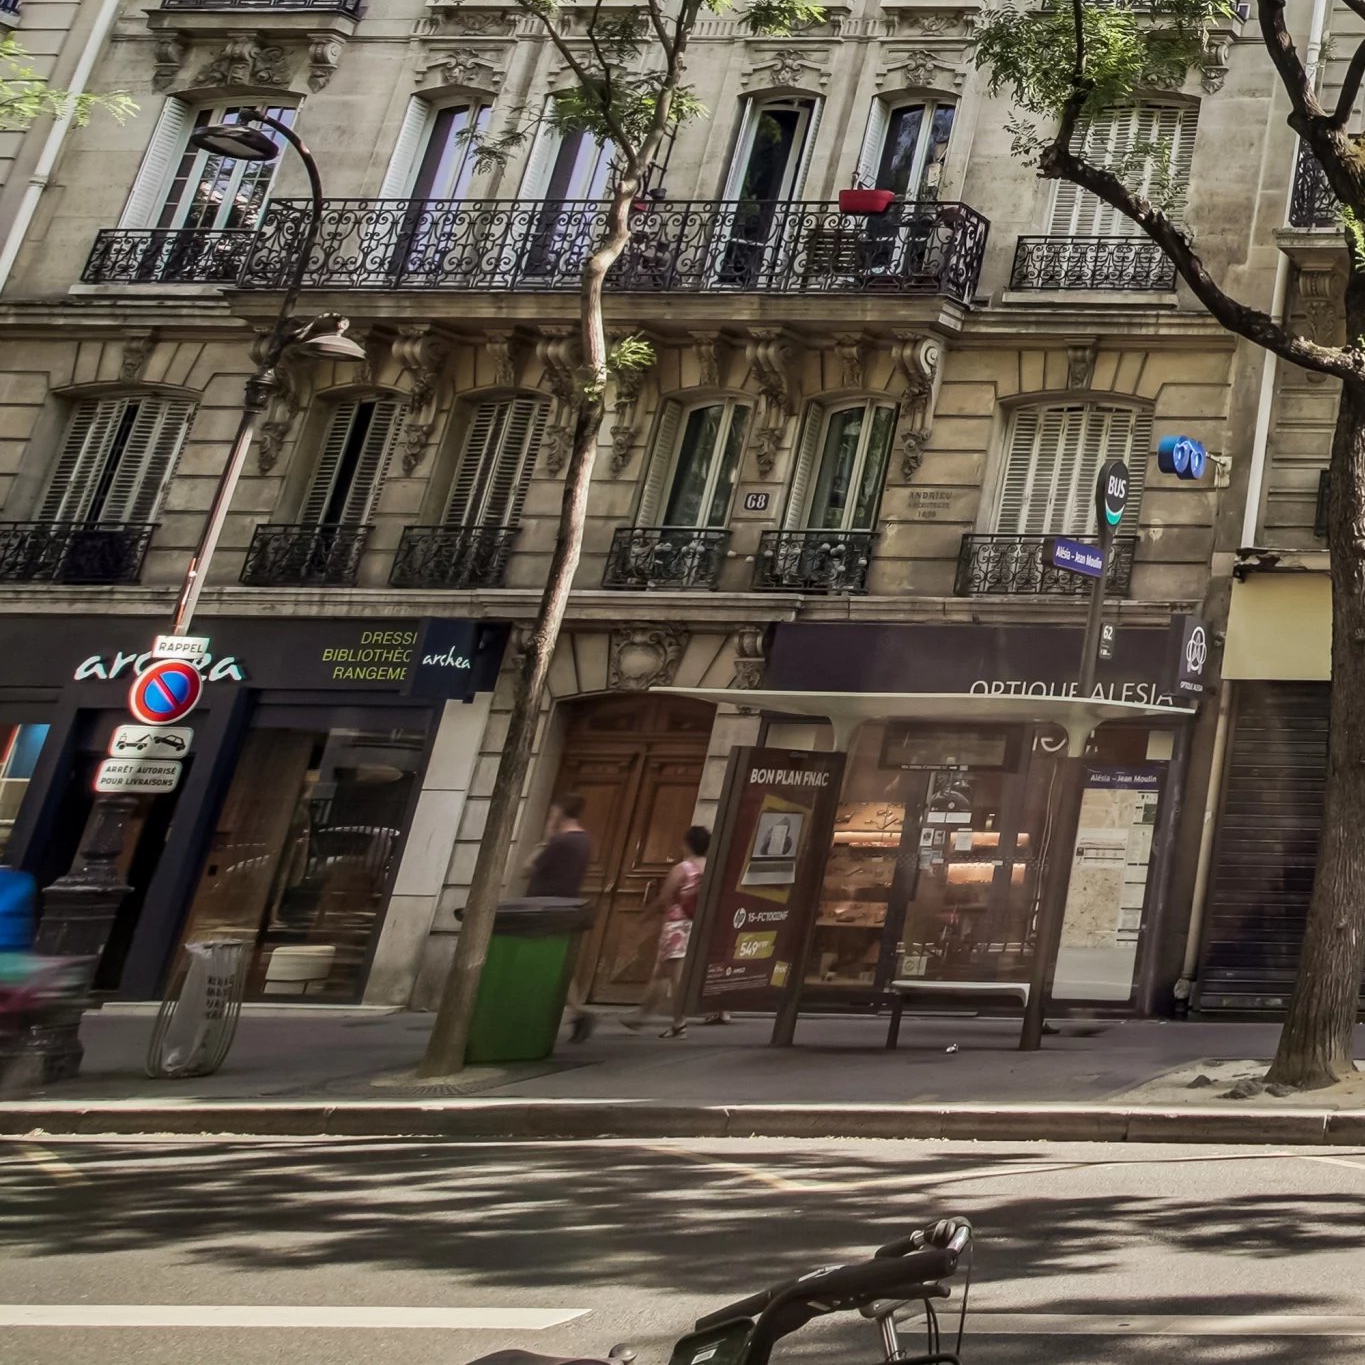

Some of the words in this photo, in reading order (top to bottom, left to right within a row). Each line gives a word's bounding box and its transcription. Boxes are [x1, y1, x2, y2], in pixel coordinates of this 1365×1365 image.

[1108, 475, 1126, 498] BUS
[747, 495, 766, 508] 68
[1056, 546, 1070, 560] Alésia
[1075, 551, 1086, 564] Jean
[361, 632, 417, 644] DRESSI
[1103, 625, 1113, 640] 62
[159, 642, 203, 654] RAPPEL
[422, 645, 471, 669] archea
[332, 667, 407, 680] RANGEME
[105, 765, 133, 774] ARRÊT
[136, 767, 177, 775] AUTORISÉ
[101, 777, 124, 785] POUR
[125, 779, 174, 787] LIVRAISONS
[750, 768, 775, 784] BON
[775, 770, 803, 785] PLAN
[802, 771, 830, 786] FNAC
